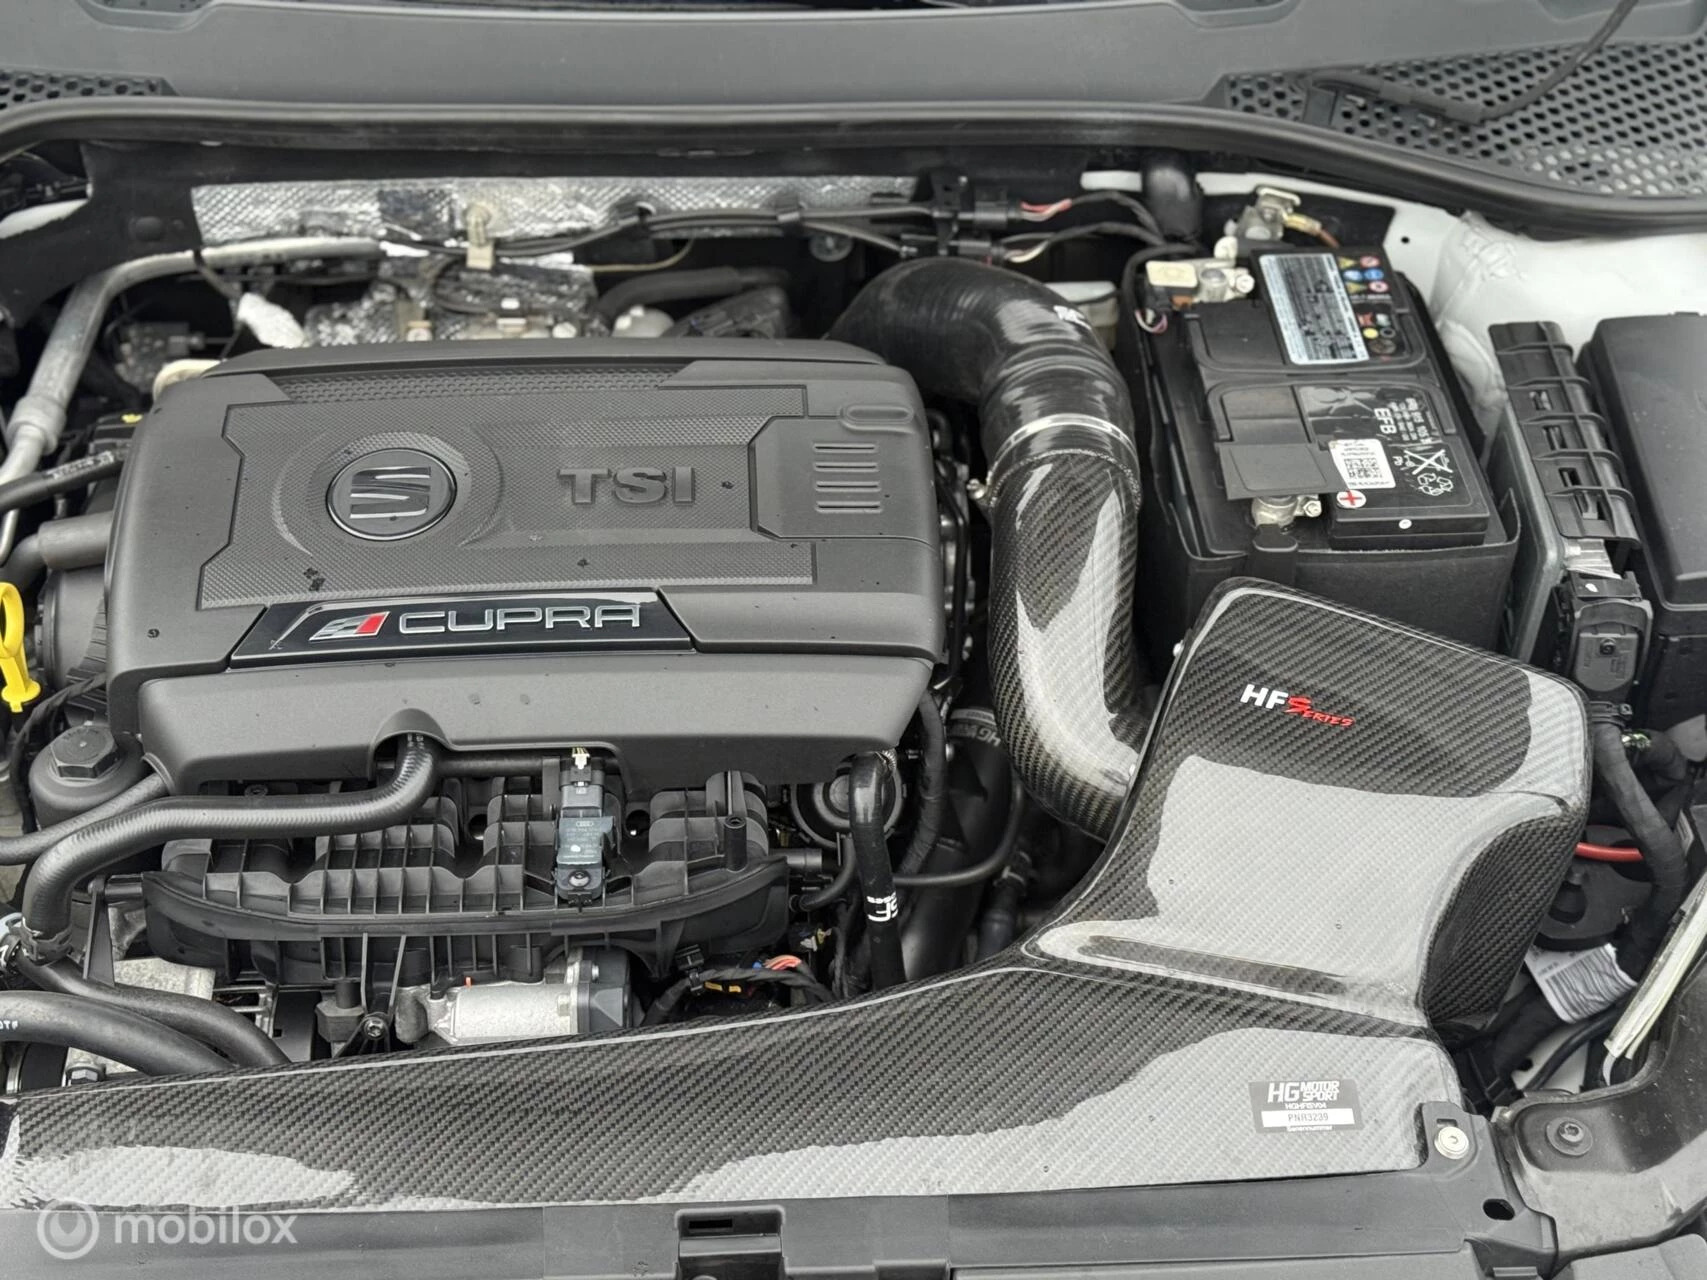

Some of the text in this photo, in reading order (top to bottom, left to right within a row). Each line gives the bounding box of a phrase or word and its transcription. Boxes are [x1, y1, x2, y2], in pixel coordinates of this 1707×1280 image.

[1374, 408, 1398, 434] EFB
[557, 466, 696, 505] TSI
[399, 604, 641, 634] CUPRA
[1240, 684, 1289, 709] HF
[1267, 1080, 1340, 1103] HG MOTOR
[1302, 1091, 1338, 1102] SPORT
